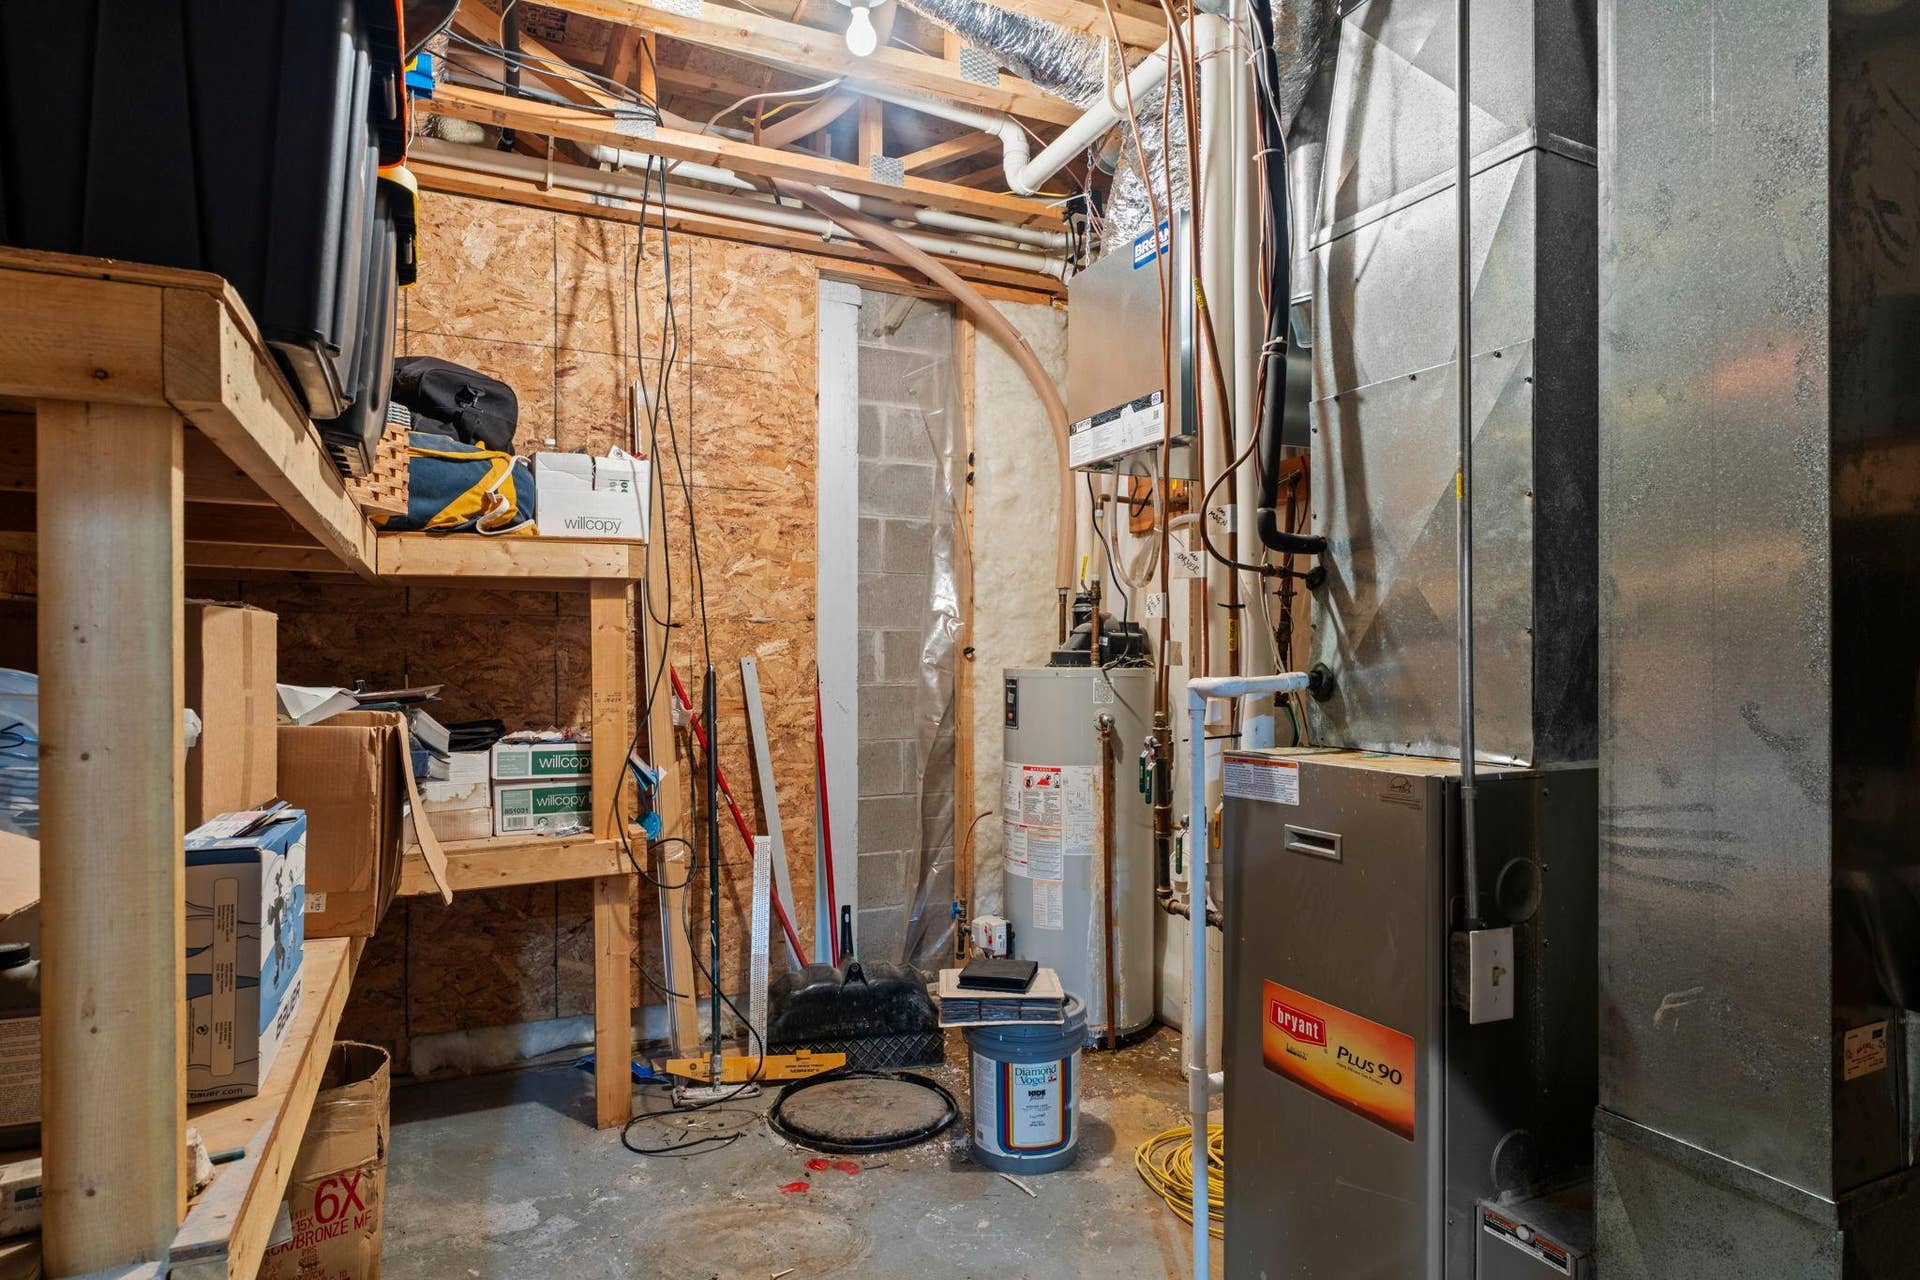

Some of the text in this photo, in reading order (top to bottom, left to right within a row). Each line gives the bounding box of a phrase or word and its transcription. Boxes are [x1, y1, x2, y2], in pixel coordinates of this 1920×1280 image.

[564, 516, 622, 534] willcopy
[539, 754, 592, 770] willcop
[536, 794, 586, 808] willcopy
[275, 980, 301, 1040] BAUER
[1277, 1007, 1319, 1039] bryant
[1015, 1064, 1057, 1077] Diamond
[1378, 1063, 1403, 1085] 90
[1020, 1075, 1046, 1086] Vogel
[189, 1087, 243, 1099] bauer.com
[314, 1169, 365, 1224] 6X
